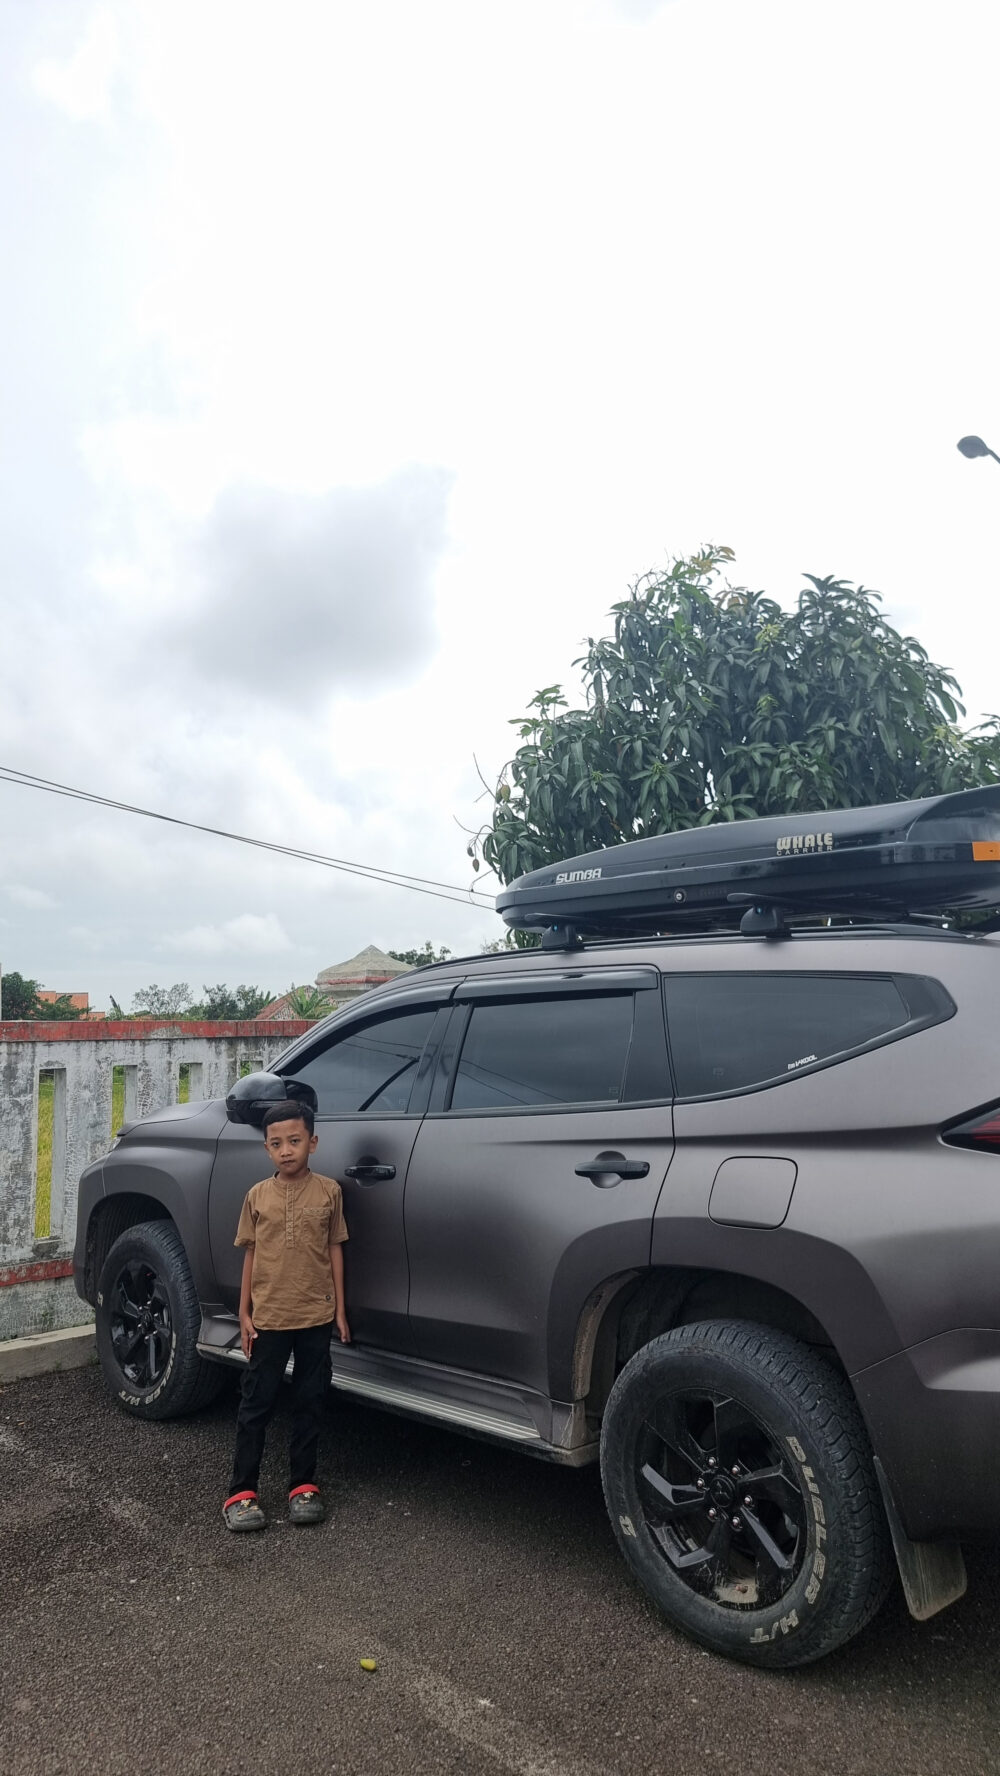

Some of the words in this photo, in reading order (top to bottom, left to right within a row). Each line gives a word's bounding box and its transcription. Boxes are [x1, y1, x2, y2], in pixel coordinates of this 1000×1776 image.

[776, 832, 833, 851] WHALE
[776, 845, 833, 856] CARRIER
[555, 867, 602, 885] SUMBA
[785, 1436, 827, 1605] DUELER
[750, 1608, 799, 1643] H/T
